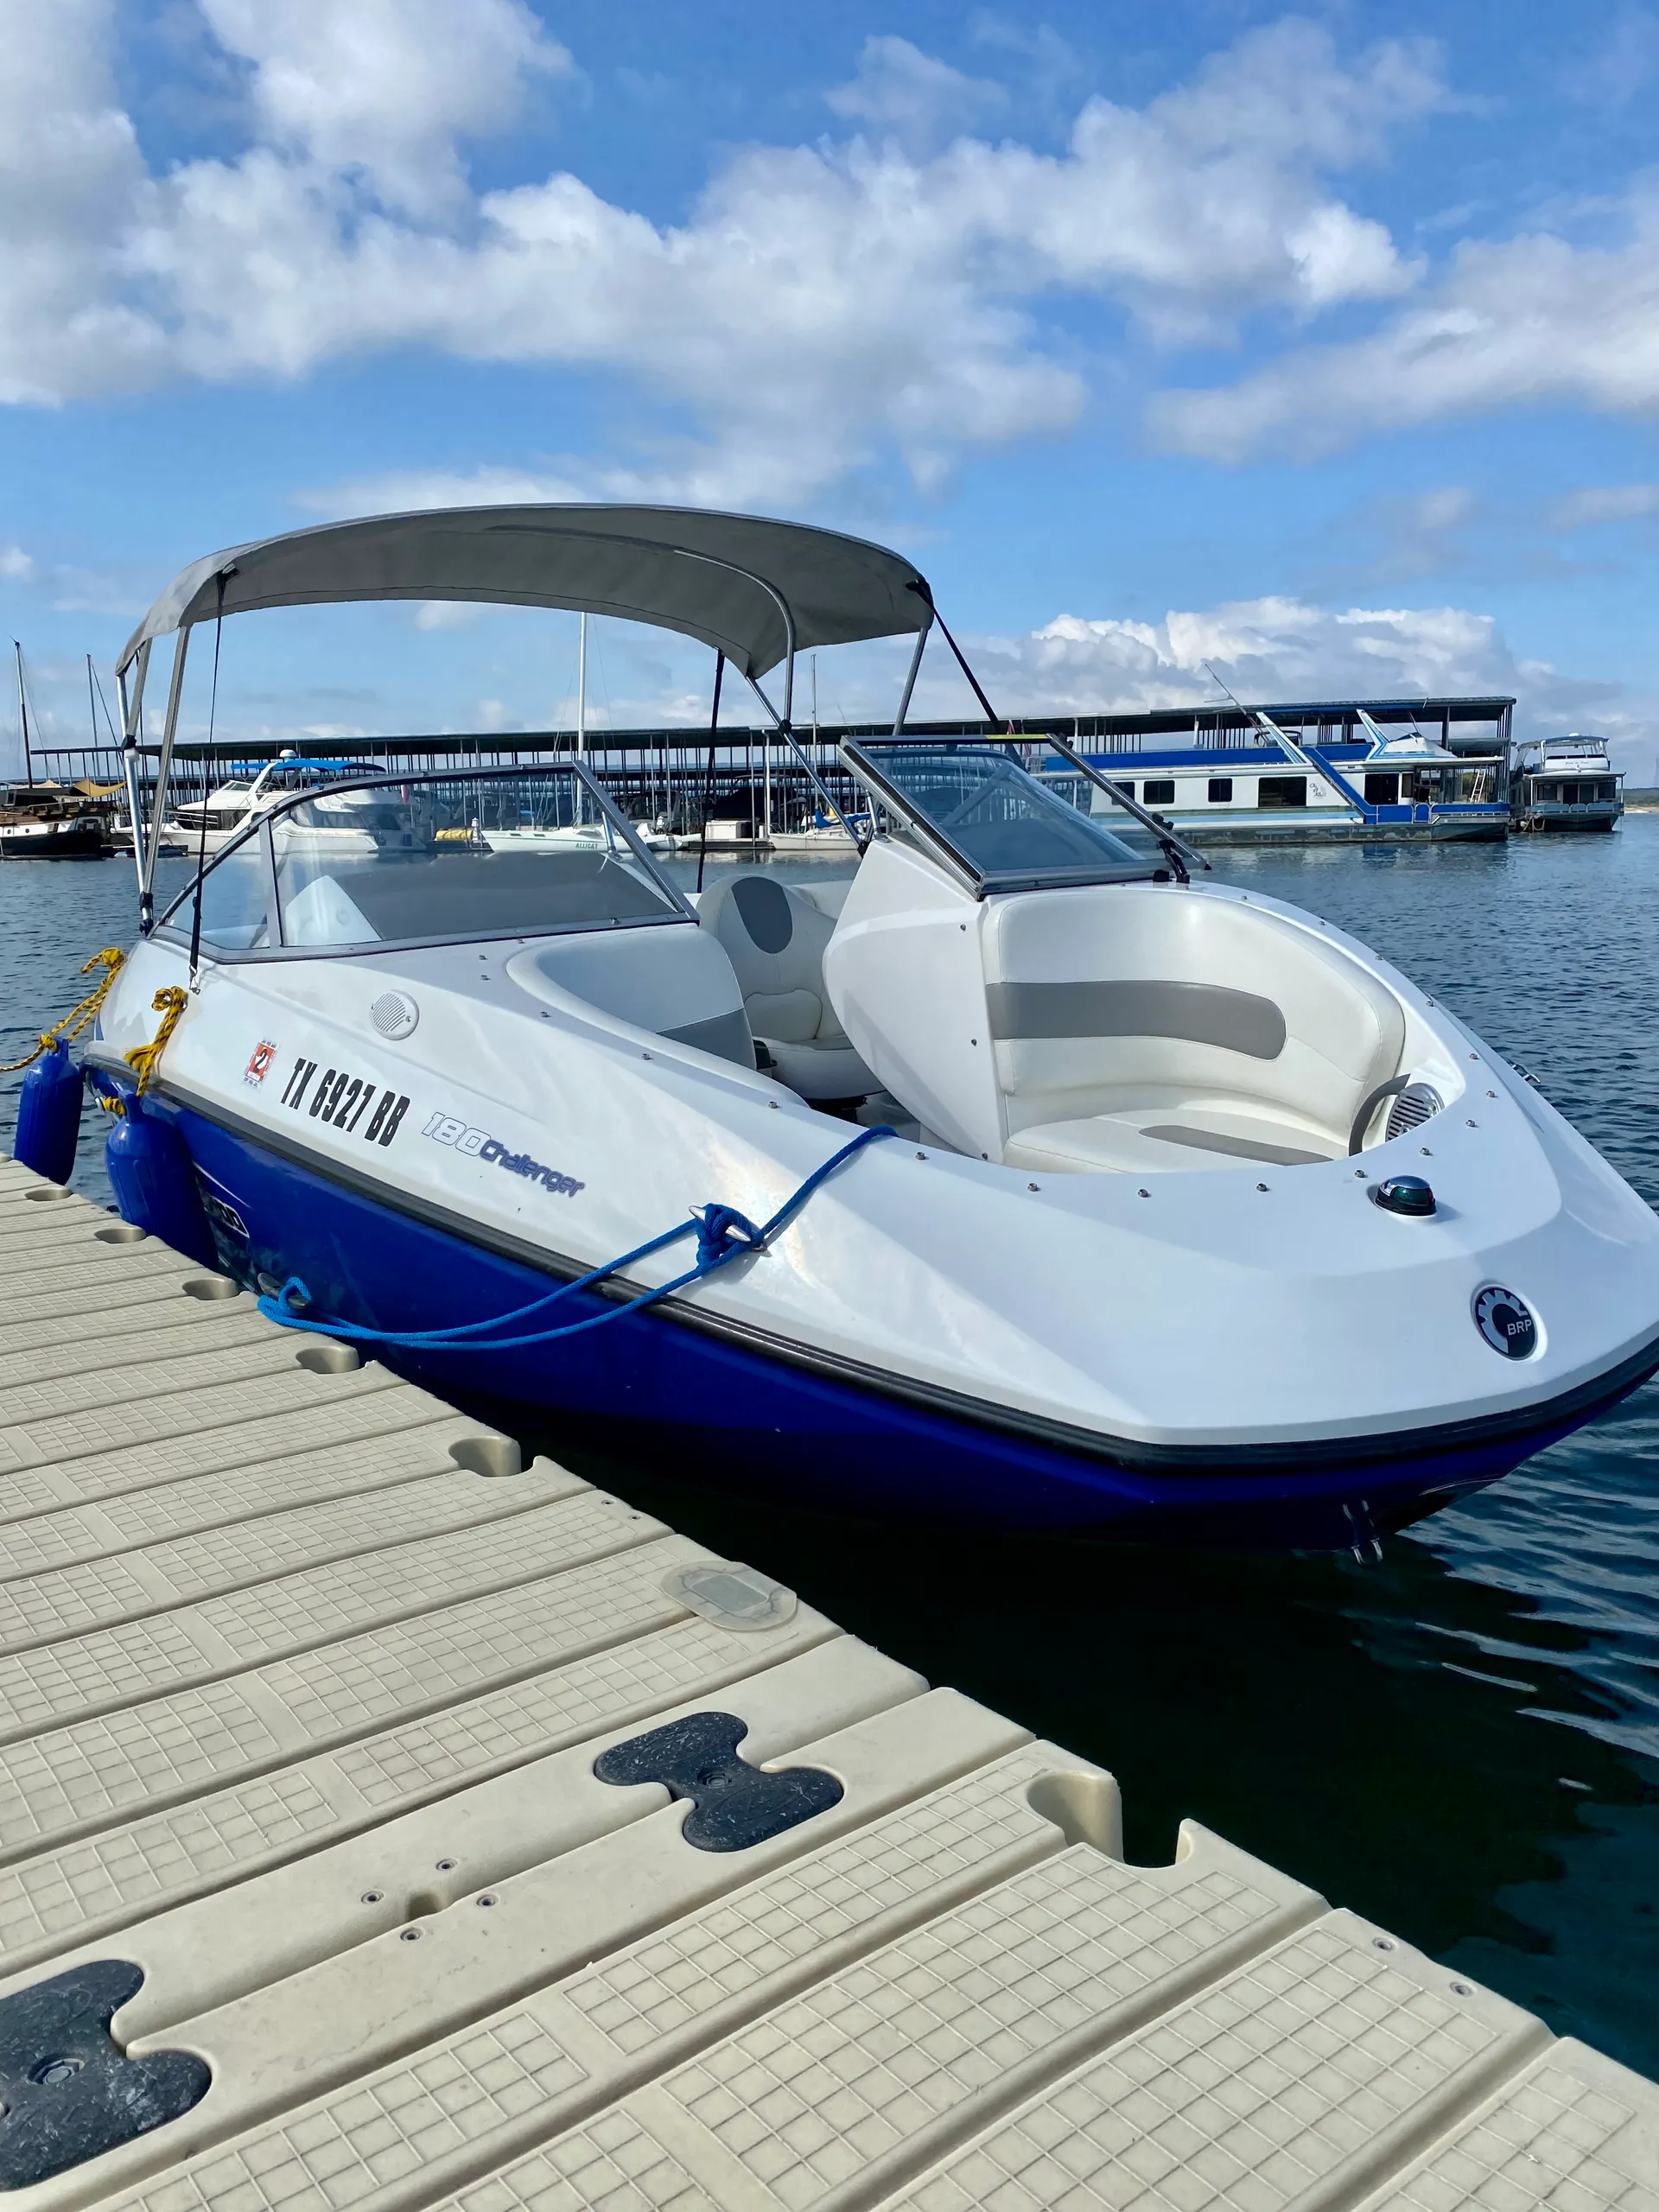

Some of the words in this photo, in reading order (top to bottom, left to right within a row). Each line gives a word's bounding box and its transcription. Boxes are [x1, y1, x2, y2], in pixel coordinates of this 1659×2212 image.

[280, 1057, 318, 1110] TX
[308, 1068, 377, 1133] 6927
[364, 1090, 411, 1147] BB
[422, 1111, 492, 1157] 180
[480, 1139, 586, 1198] Challenger
[1507, 1319, 1532, 1336] BRP
